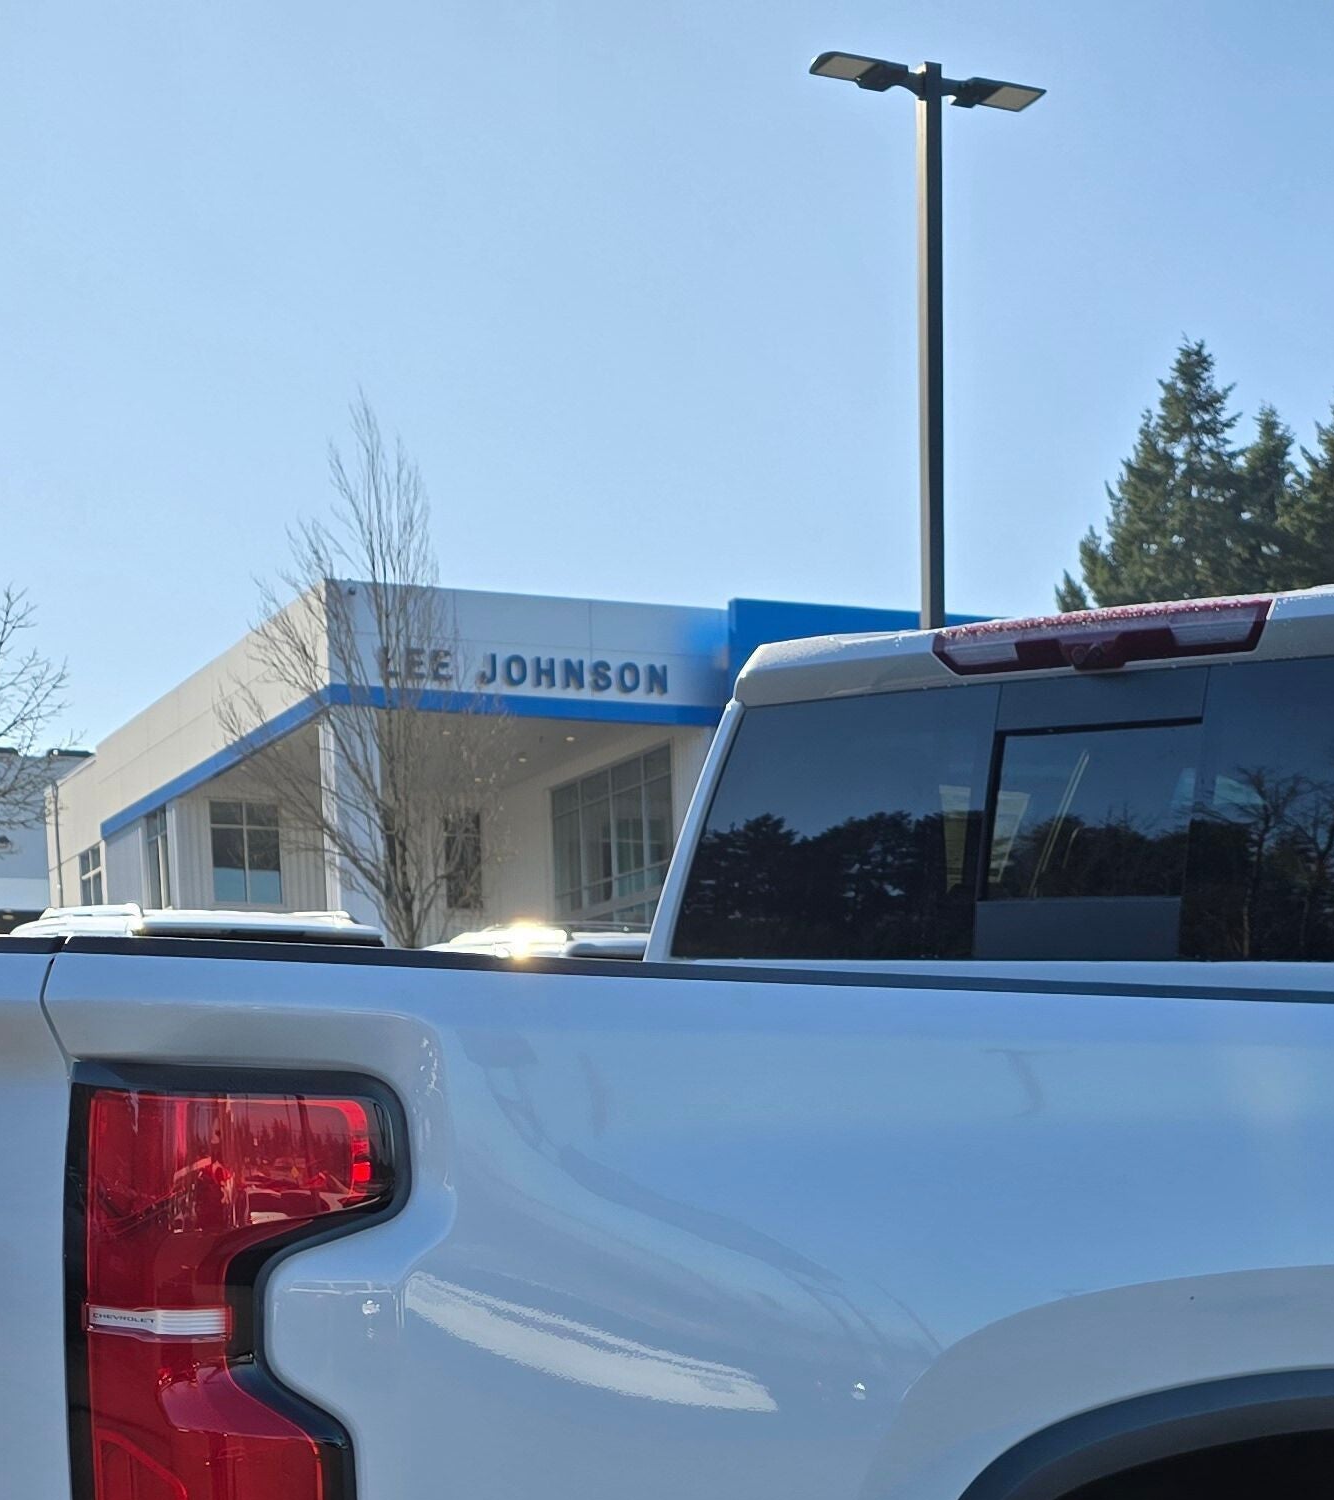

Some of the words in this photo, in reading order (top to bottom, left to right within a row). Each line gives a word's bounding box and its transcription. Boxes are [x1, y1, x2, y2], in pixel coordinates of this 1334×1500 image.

[376, 646, 453, 682] LEE
[479, 652, 668, 696] JOHNSON
[93, 1312, 154, 1323] CHEVROLET
